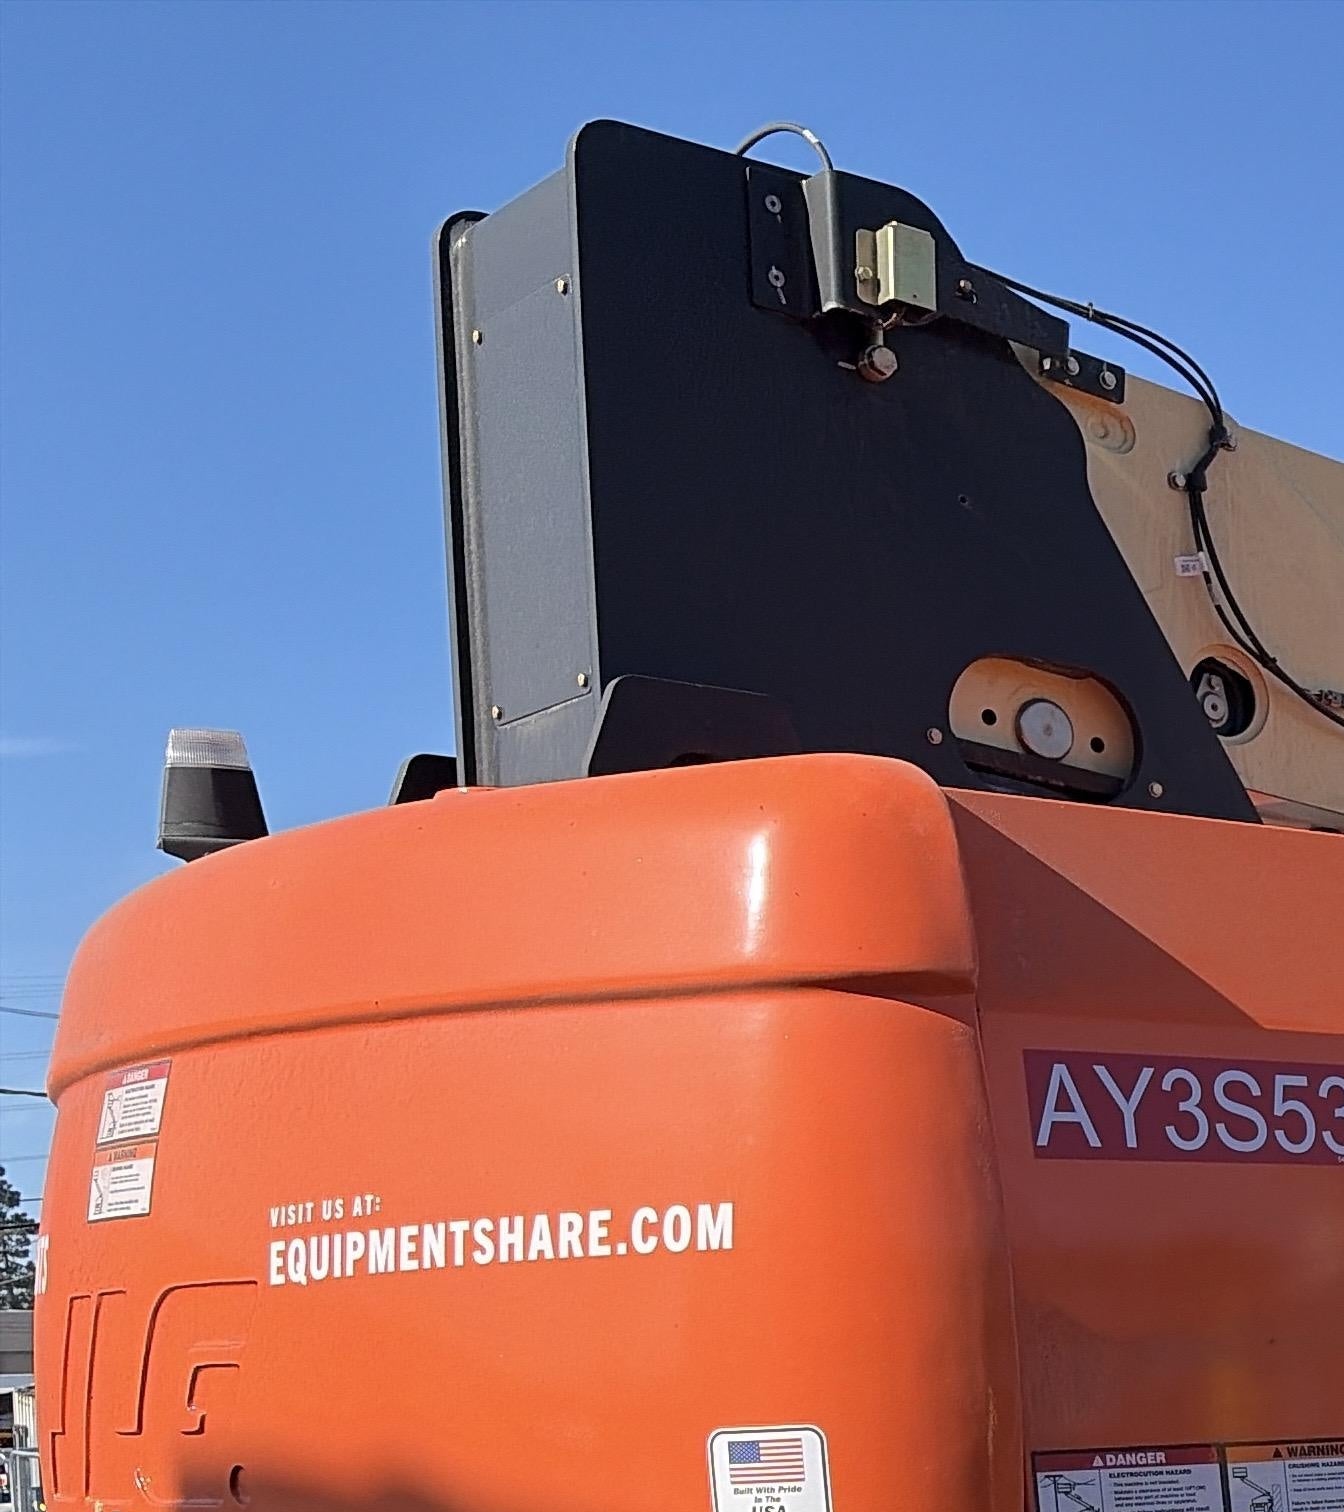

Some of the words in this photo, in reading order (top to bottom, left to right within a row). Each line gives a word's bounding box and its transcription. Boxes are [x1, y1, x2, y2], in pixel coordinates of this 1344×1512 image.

[270, 1202, 314, 1228] VISIT
[322, 1198, 344, 1221] US
[352, 1194, 381, 1217] AT:
[269, 1202, 734, 1285] EQUIPMENTSHARE.COM
[1105, 1452, 1167, 1466] DANGER
[1165, 1468, 1192, 1476] HAZARD
[733, 1486, 754, 1495] Built
[755, 1486, 775, 1494] With
[778, 1485, 802, 1493] Pride
[765, 1495, 781, 1503] The
